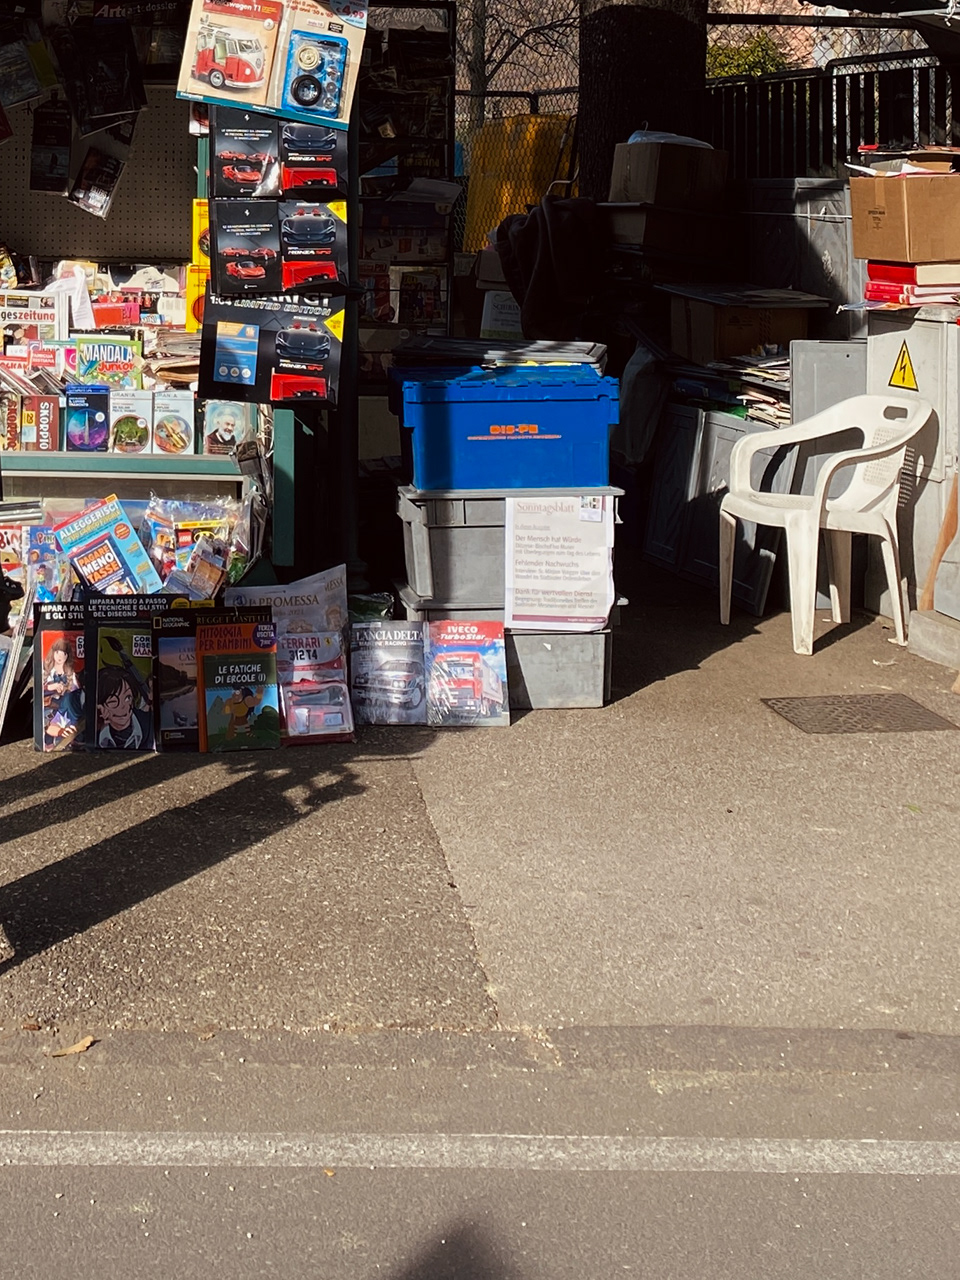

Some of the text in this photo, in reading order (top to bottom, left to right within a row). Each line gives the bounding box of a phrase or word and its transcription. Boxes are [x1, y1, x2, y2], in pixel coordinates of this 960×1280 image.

[144, 0, 178, 13] dossier
[253, 2, 262, 13] T1
[234, 299, 281, 312] LIMITED
[283, 304, 332, 317] EDITION
[82, 345, 134, 362] MANDALA
[98, 361, 134, 372] Junior
[6, 400, 19, 449] SKORPIO
[26, 413, 35, 425] 29
[38, 401, 50, 450] SKORPIO
[517, 501, 575, 516] Sonntagsblatt
[60, 501, 119, 540] ALLEGGERISCI
[78, 543, 111, 566] PAGARE
[82, 552, 115, 576] MENO
[545, 560, 580, 568] Nachwuchs
[87, 560, 120, 584] TASSE
[542, 589, 574, 597] wertvollen
[258, 594, 320, 608] PROMESSA
[200, 626, 243, 638] MITOLOGIA
[356, 630, 424, 641] LANCIA DELTA
[447, 625, 478, 634] IVECO
[280, 637, 321, 649] FERRARI
[440, 633, 486, 641] TurboStar
[200, 638, 252, 651] PER BAMBINI
[289, 649, 318, 661] 312 T4
[218, 664, 261, 674] LE FATICHE
[215, 674, 256, 684] DI ERCOLE
